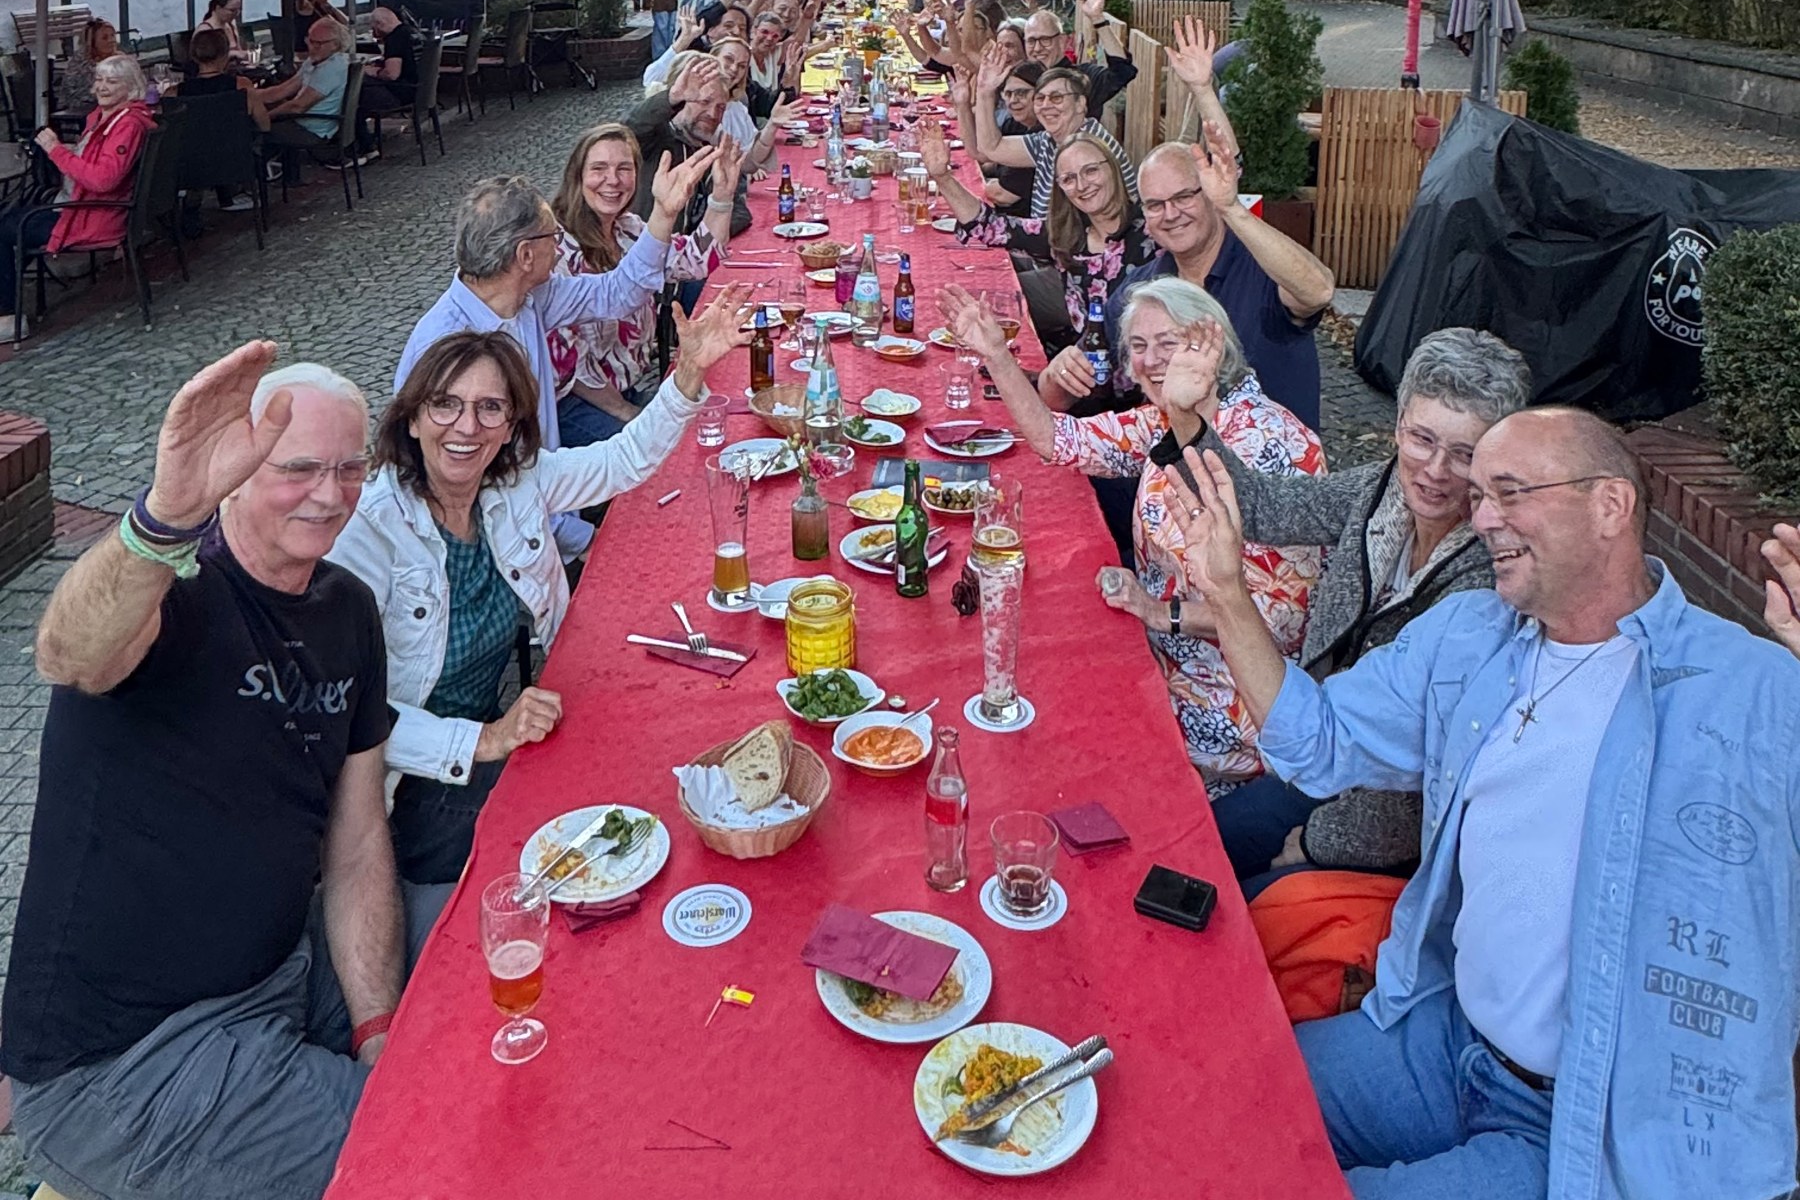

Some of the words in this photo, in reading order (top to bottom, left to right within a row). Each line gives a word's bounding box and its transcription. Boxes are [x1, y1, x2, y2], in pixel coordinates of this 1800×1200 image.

[1649, 298, 1671, 327] FOR
[679, 906, 735, 921] Warsteiner
[1646, 967, 1752, 1020] FOOTBALL
[1673, 1003, 1722, 1036] CLUB
[1687, 1134, 1711, 1157] VII
